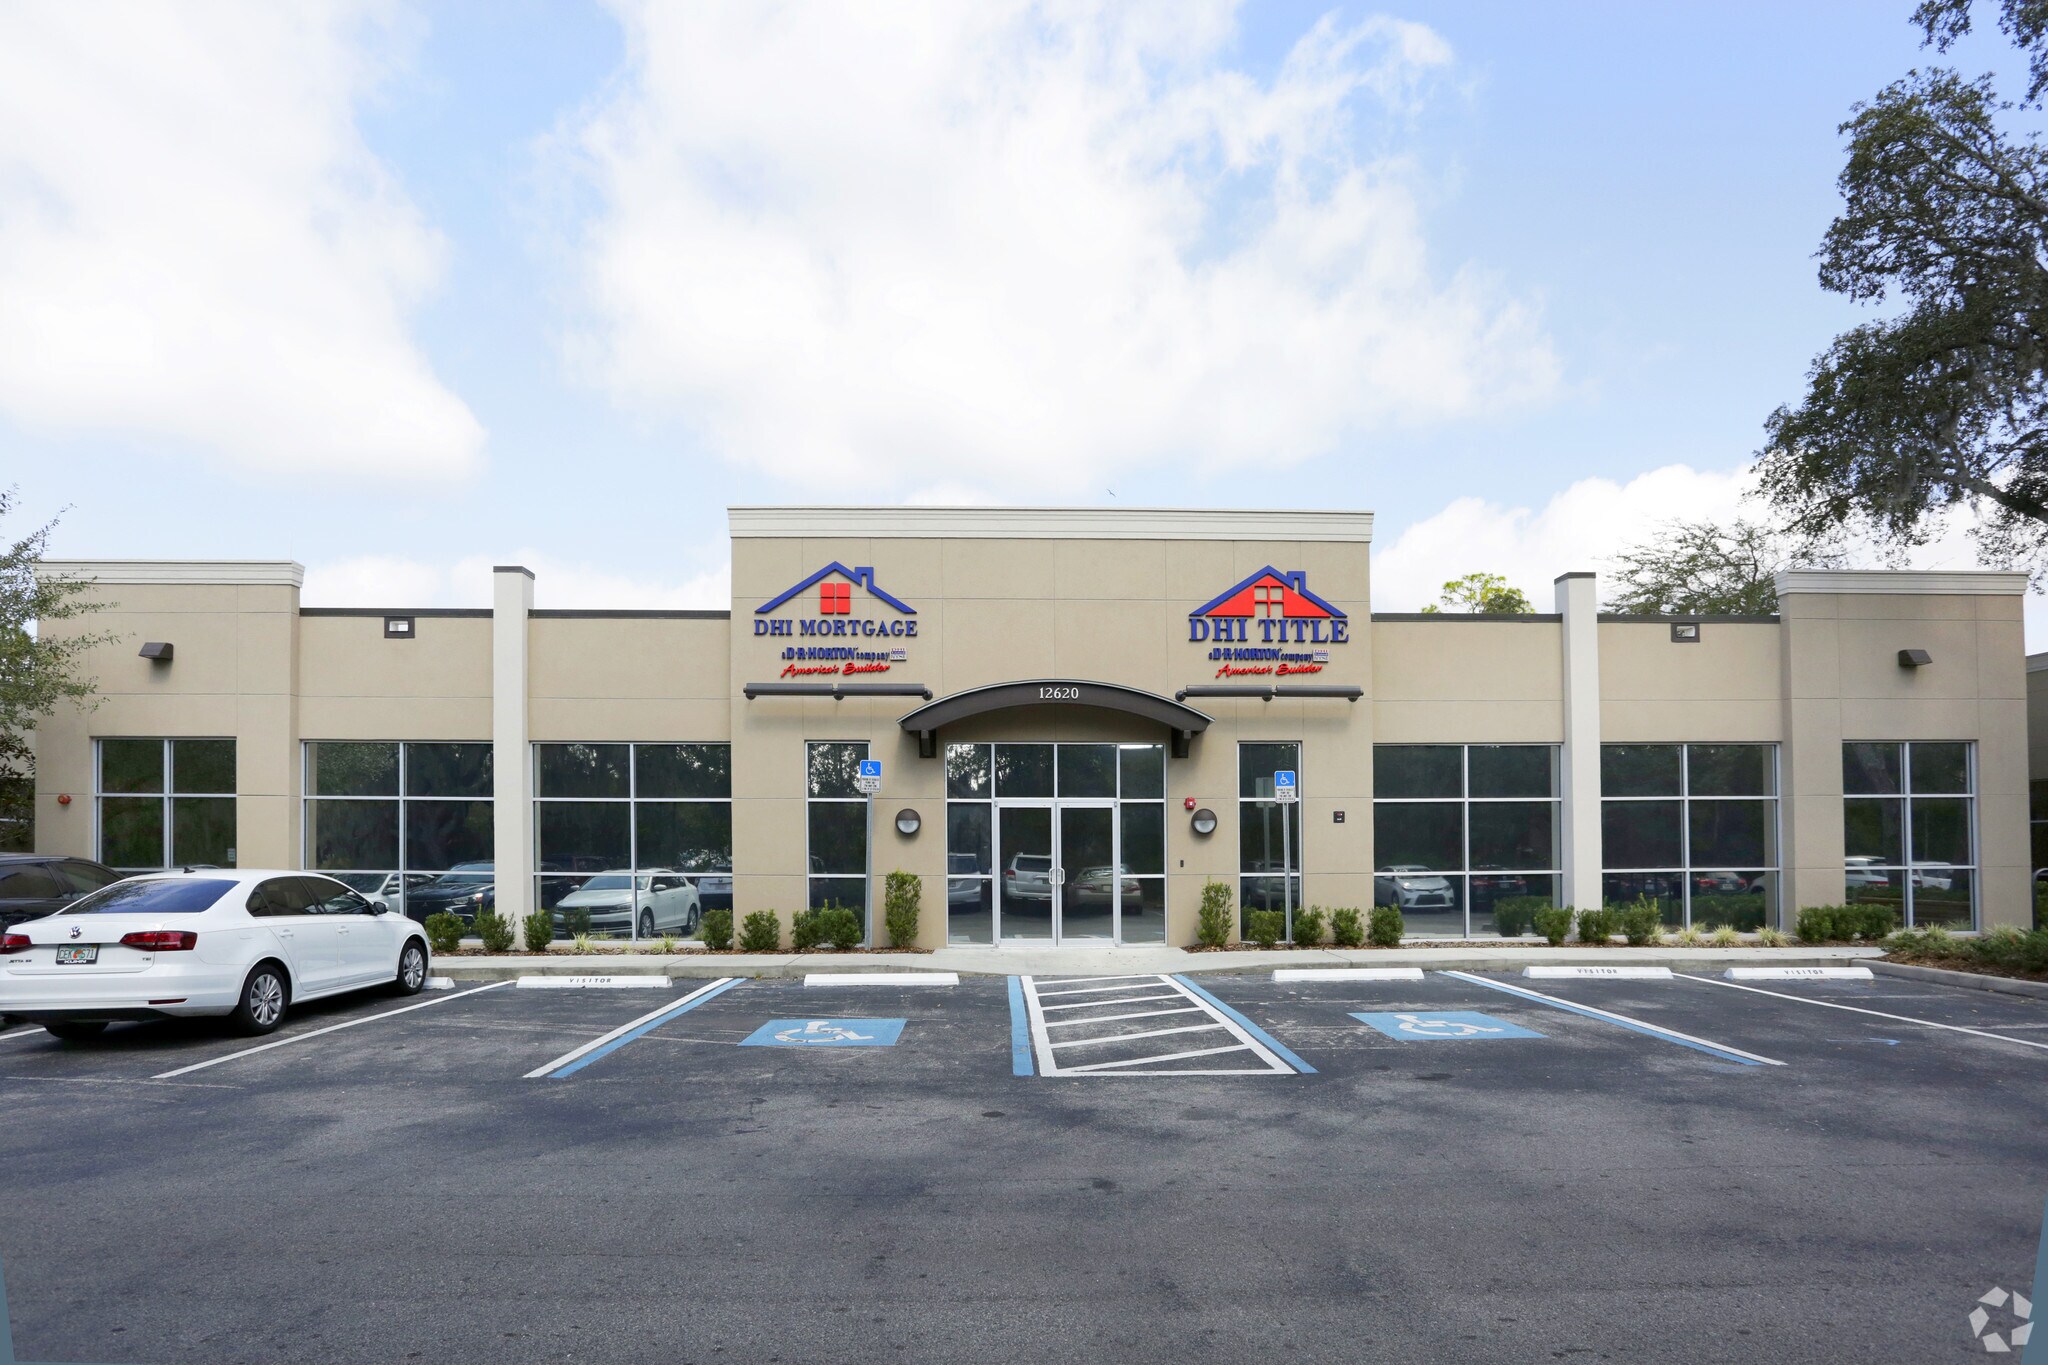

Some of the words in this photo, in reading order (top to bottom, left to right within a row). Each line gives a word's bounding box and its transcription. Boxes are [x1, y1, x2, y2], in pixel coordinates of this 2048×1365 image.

[754, 619, 793, 636] DHI
[800, 619, 918, 637] MORTGAGE
[1189, 618, 1248, 642] DHI
[1258, 619, 1350, 643] TITLE
[856, 651, 891, 663] company
[1280, 652, 1313, 664] company
[780, 663, 840, 678] America's
[842, 662, 891, 676] Builder
[1215, 663, 1273, 679] America's
[1275, 663, 1323, 676] Builder
[1039, 687, 1079, 699] 12620
